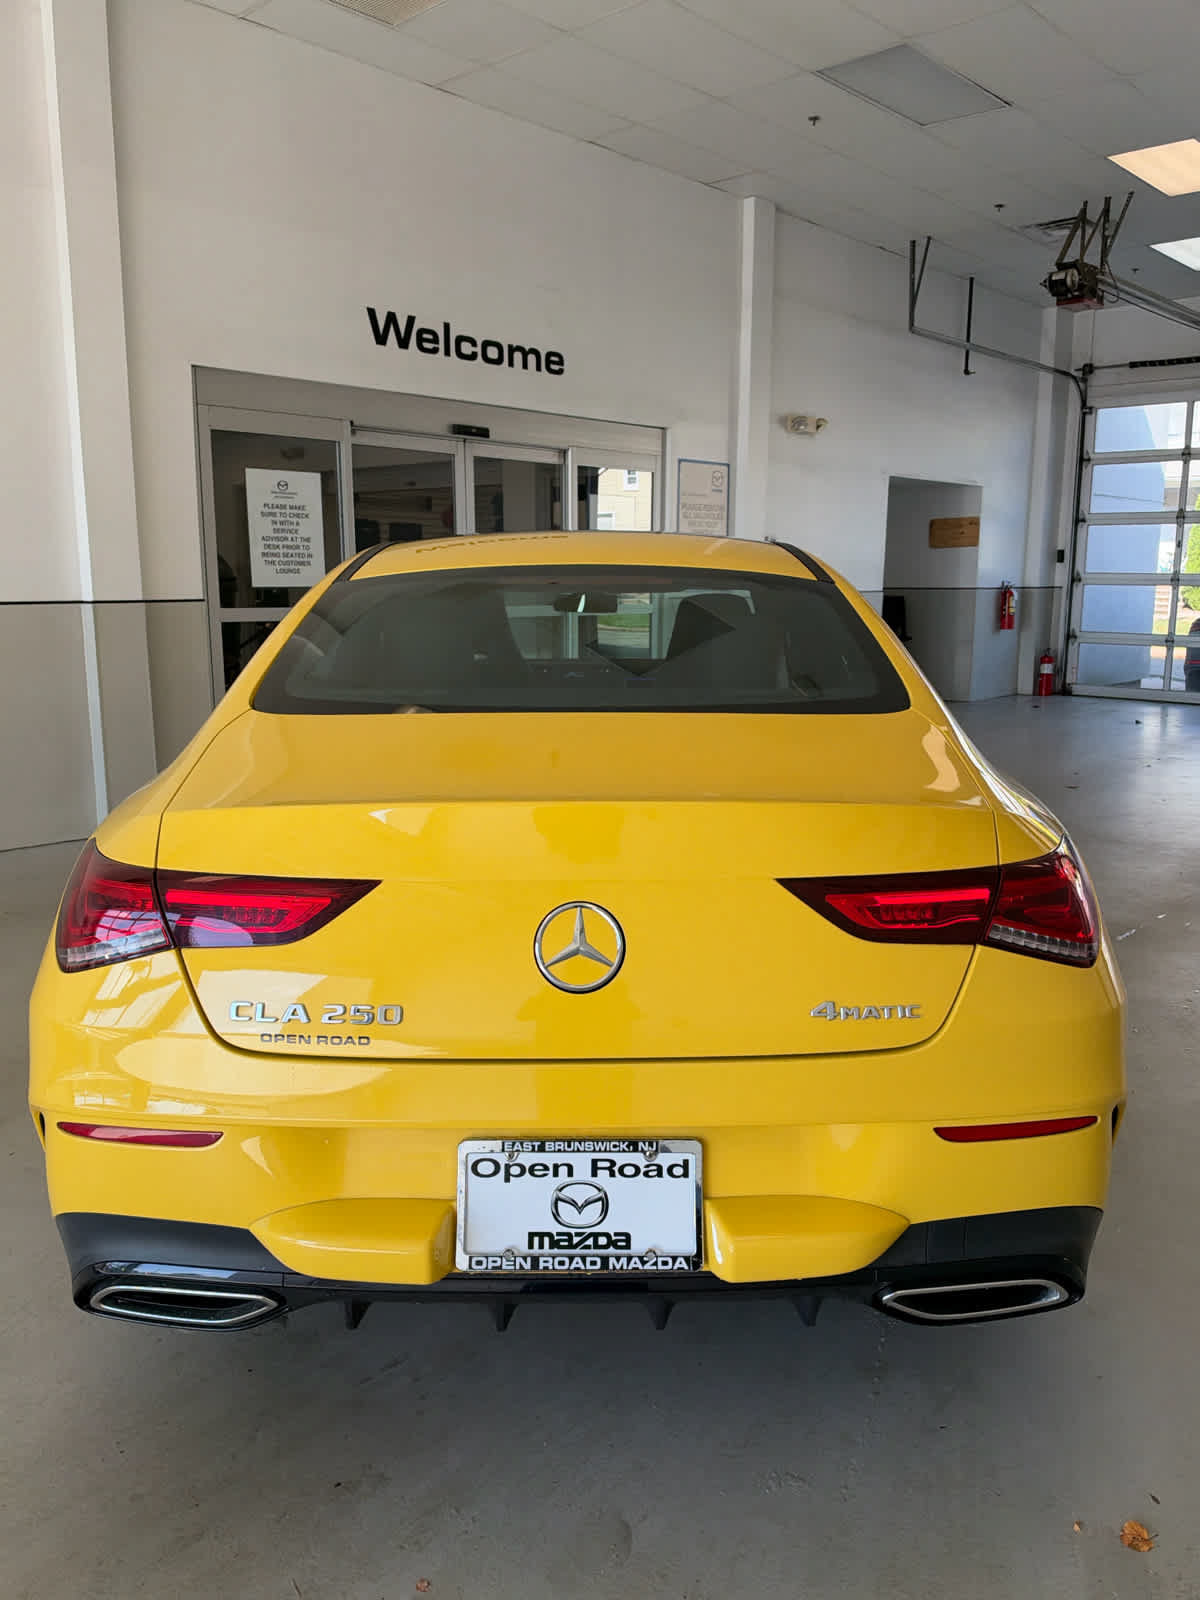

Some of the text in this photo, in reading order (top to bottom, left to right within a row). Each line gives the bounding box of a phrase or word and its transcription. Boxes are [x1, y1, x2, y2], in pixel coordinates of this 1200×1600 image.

[366, 306, 565, 376] Welcome
[229, 1000, 405, 1026] CLA 250
[809, 1000, 922, 1021] 4MATIC
[260, 1033, 371, 1046] OPEN ROAD
[503, 1141, 658, 1152] EAST BRUNSWICK, NJ
[470, 1157, 690, 1183] Open Road
[471, 1256, 689, 1271] OPEN ROAD MAZDA
